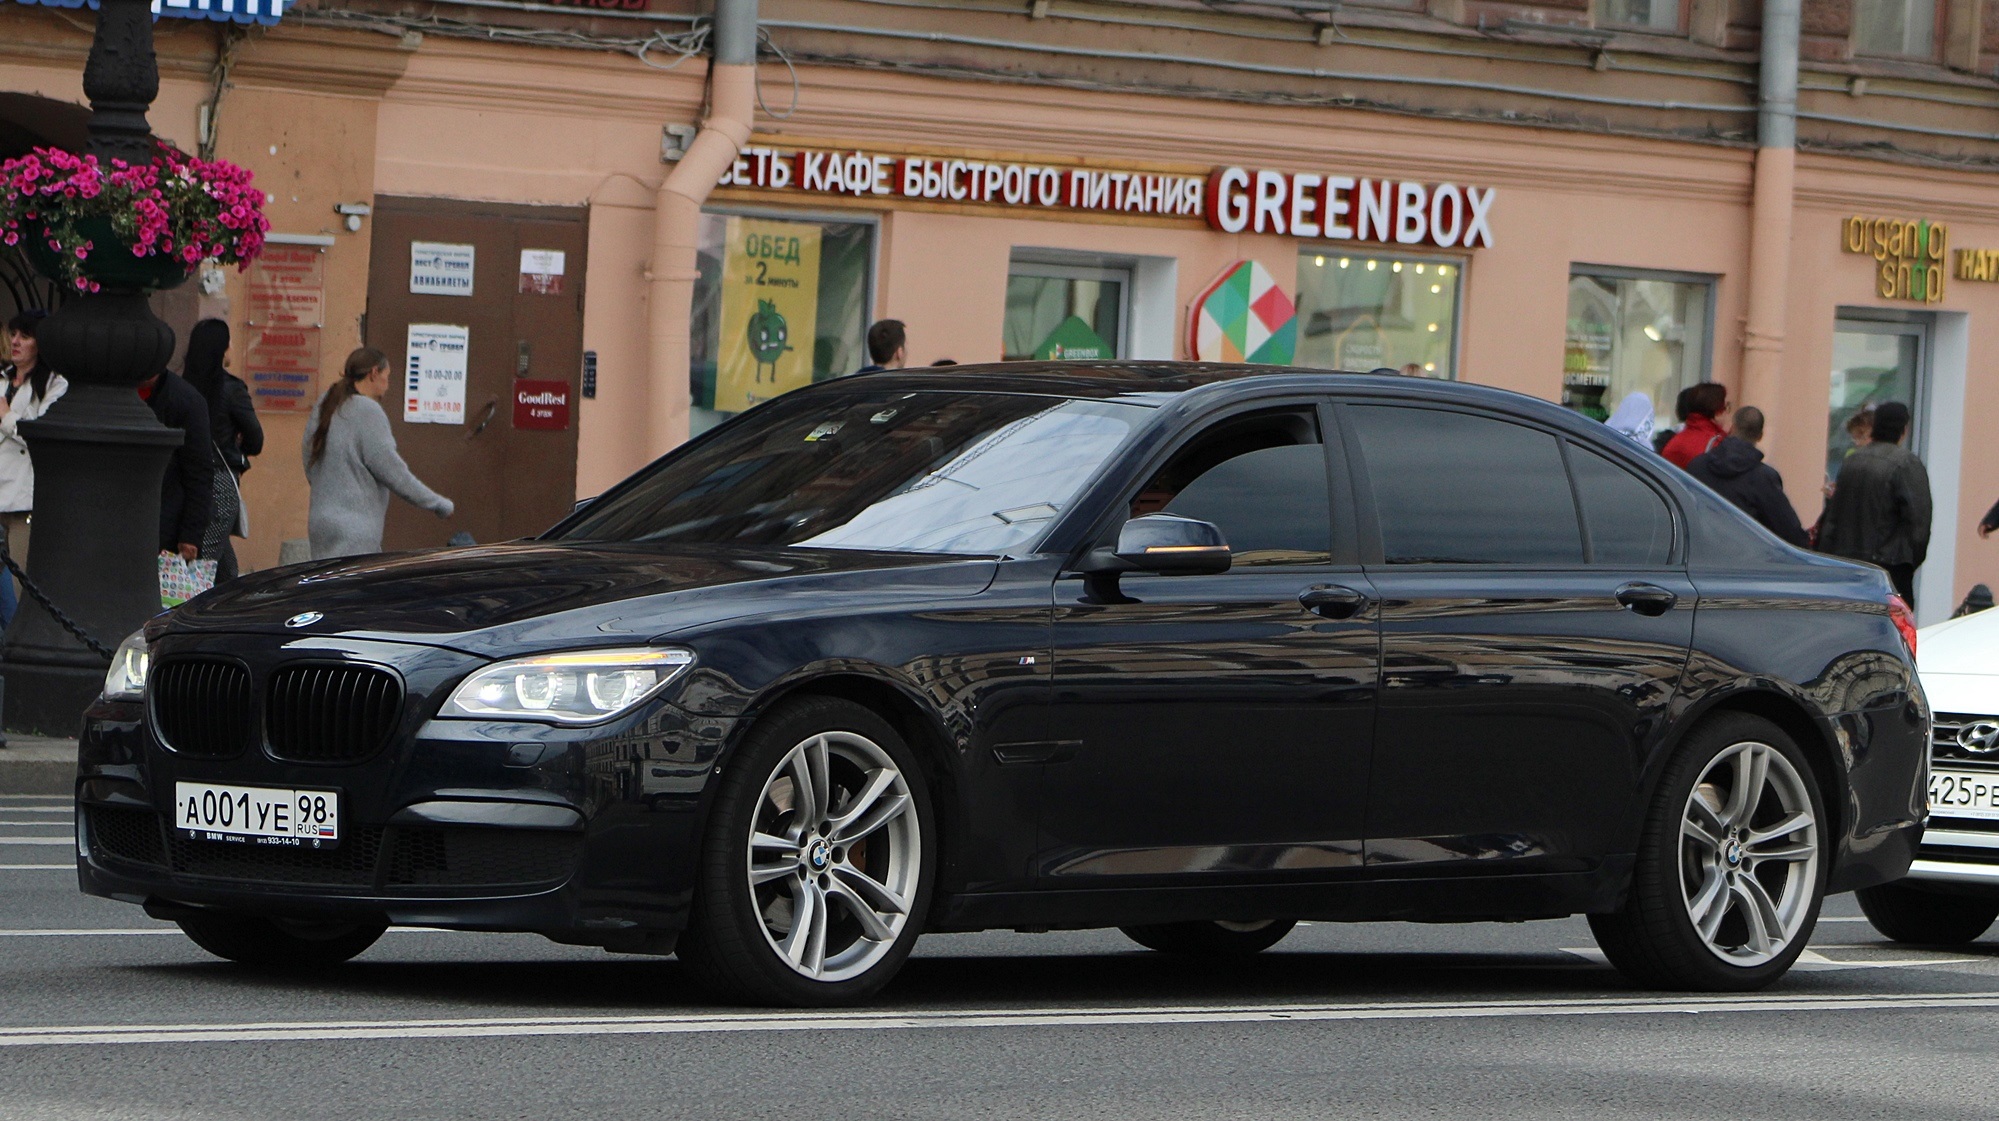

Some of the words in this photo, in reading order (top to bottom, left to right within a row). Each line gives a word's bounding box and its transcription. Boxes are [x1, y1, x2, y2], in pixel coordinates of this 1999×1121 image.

[803, 150, 891, 196] КАФЕ
[903, 157, 1059, 207] БЫСТРОГО
[1069, 170, 1203, 216] ПИТАНИЯ
[1217, 166, 1496, 249] GREENBOX
[746, 233, 800, 266] ОБЕД
[756, 261, 767, 286] 2
[1960, 248, 1999, 282] НАТ
[414, 275, 469, 287] АВИАБИЛЕТЫ
[1882, 257, 1946, 305] shop
[518, 391, 566, 405] GoodRest
[530, 408, 536, 417] 4
[298, 795, 327, 823] 98
[206, 832, 223, 841] BMW
[267, 837, 300, 846] 933-14-10
[297, 824, 318, 835] RUS
